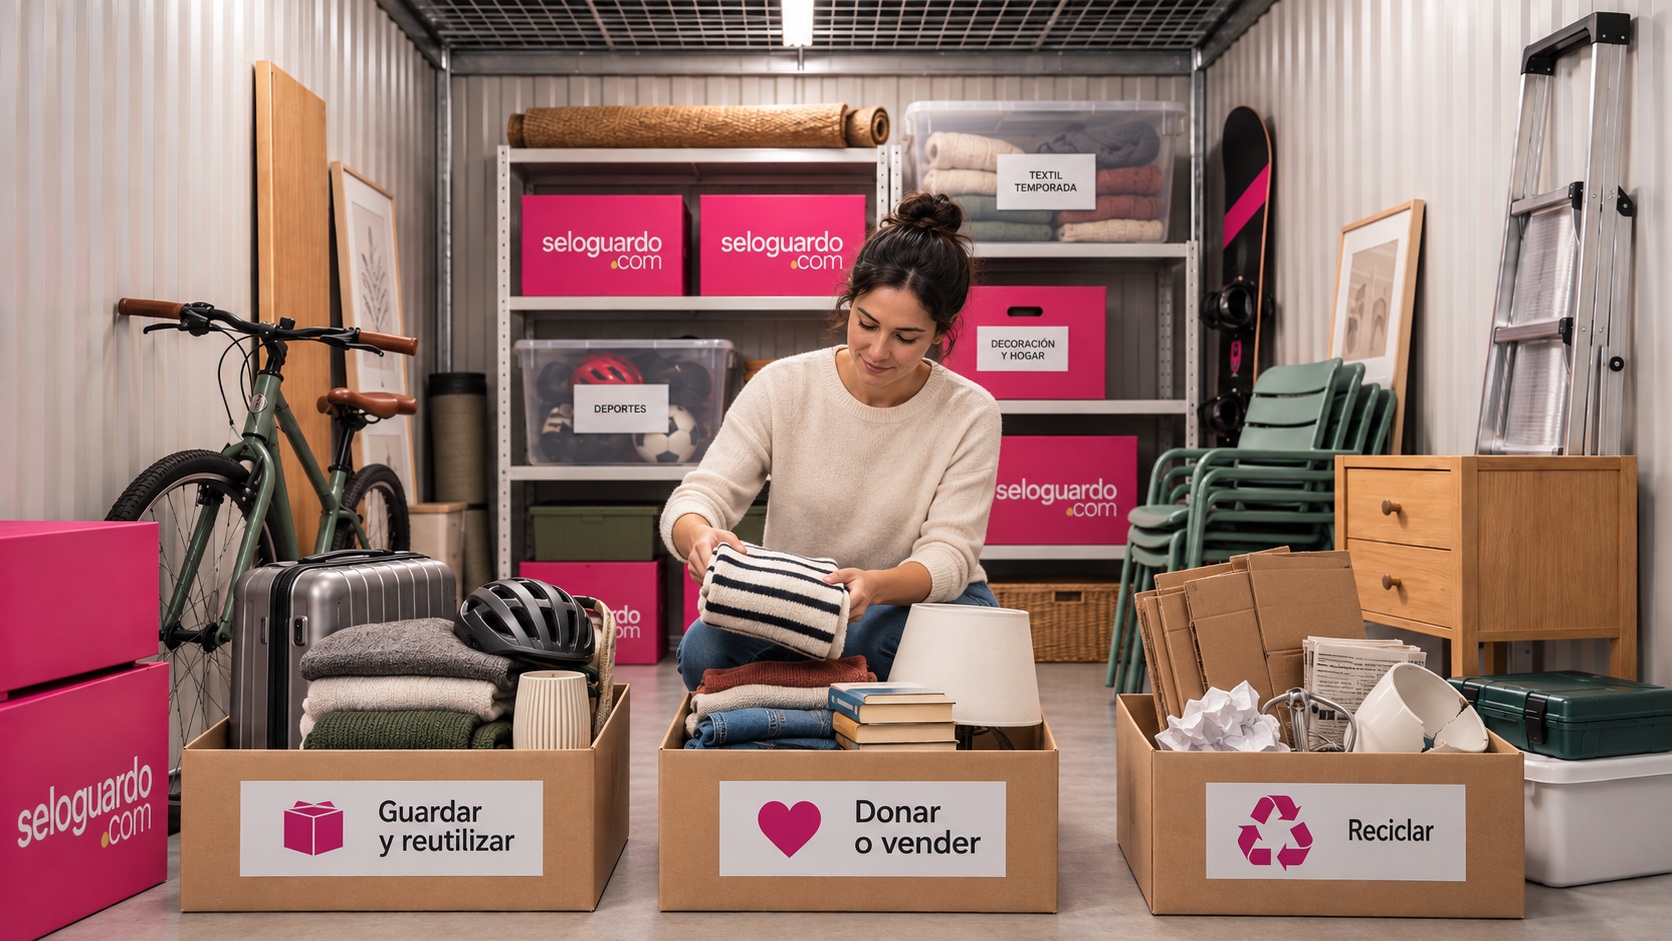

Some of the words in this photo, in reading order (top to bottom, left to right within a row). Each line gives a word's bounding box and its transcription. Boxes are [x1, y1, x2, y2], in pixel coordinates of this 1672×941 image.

[1029, 170, 1063, 180] TEXTIL
[1014, 183, 1077, 193] TEMPORADA
[542, 231, 663, 258] seloguardo
[720, 231, 844, 258] seloguardo
[610, 252, 662, 270] .com
[790, 252, 843, 270] .com
[991, 337, 1055, 349] DECORACIÓN
[1001, 351, 1008, 361] Y
[1010, 351, 1045, 361] HOGAR
[594, 404, 647, 414] DEPORTES
[995, 477, 1118, 506] seloguardo
[1065, 501, 1117, 518] .com
[17, 755, 153, 848] seloguardo
[378, 799, 483, 824] Guardar
[855, 799, 942, 824] Donar
[100, 802, 153, 849] .com
[1348, 818, 1435, 843] Reciclar
[378, 833, 395, 858] y
[402, 827, 515, 852] reutilizar
[854, 835, 873, 855] o
[880, 829, 982, 855] vender
